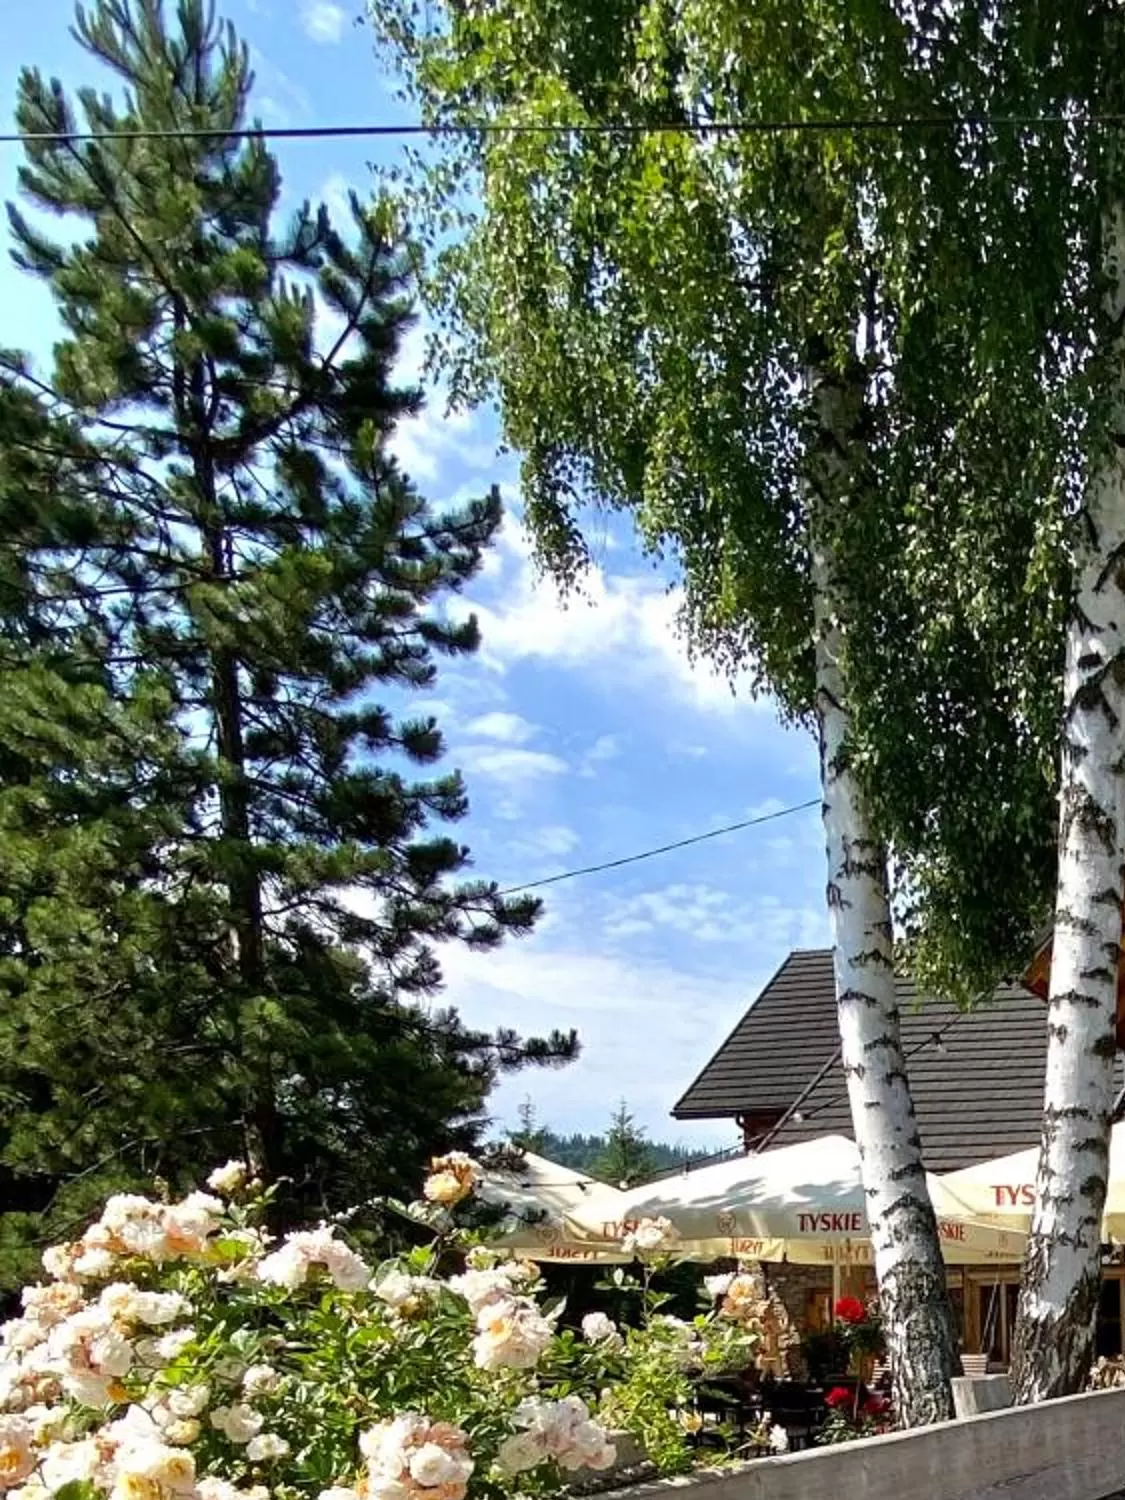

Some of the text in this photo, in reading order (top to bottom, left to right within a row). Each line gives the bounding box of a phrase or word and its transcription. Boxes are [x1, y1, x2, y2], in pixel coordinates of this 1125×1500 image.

[990, 1184, 1036, 1206] TYS
[798, 1213, 861, 1231] TYSKIE
[941, 1223, 966, 1241] SKIE
